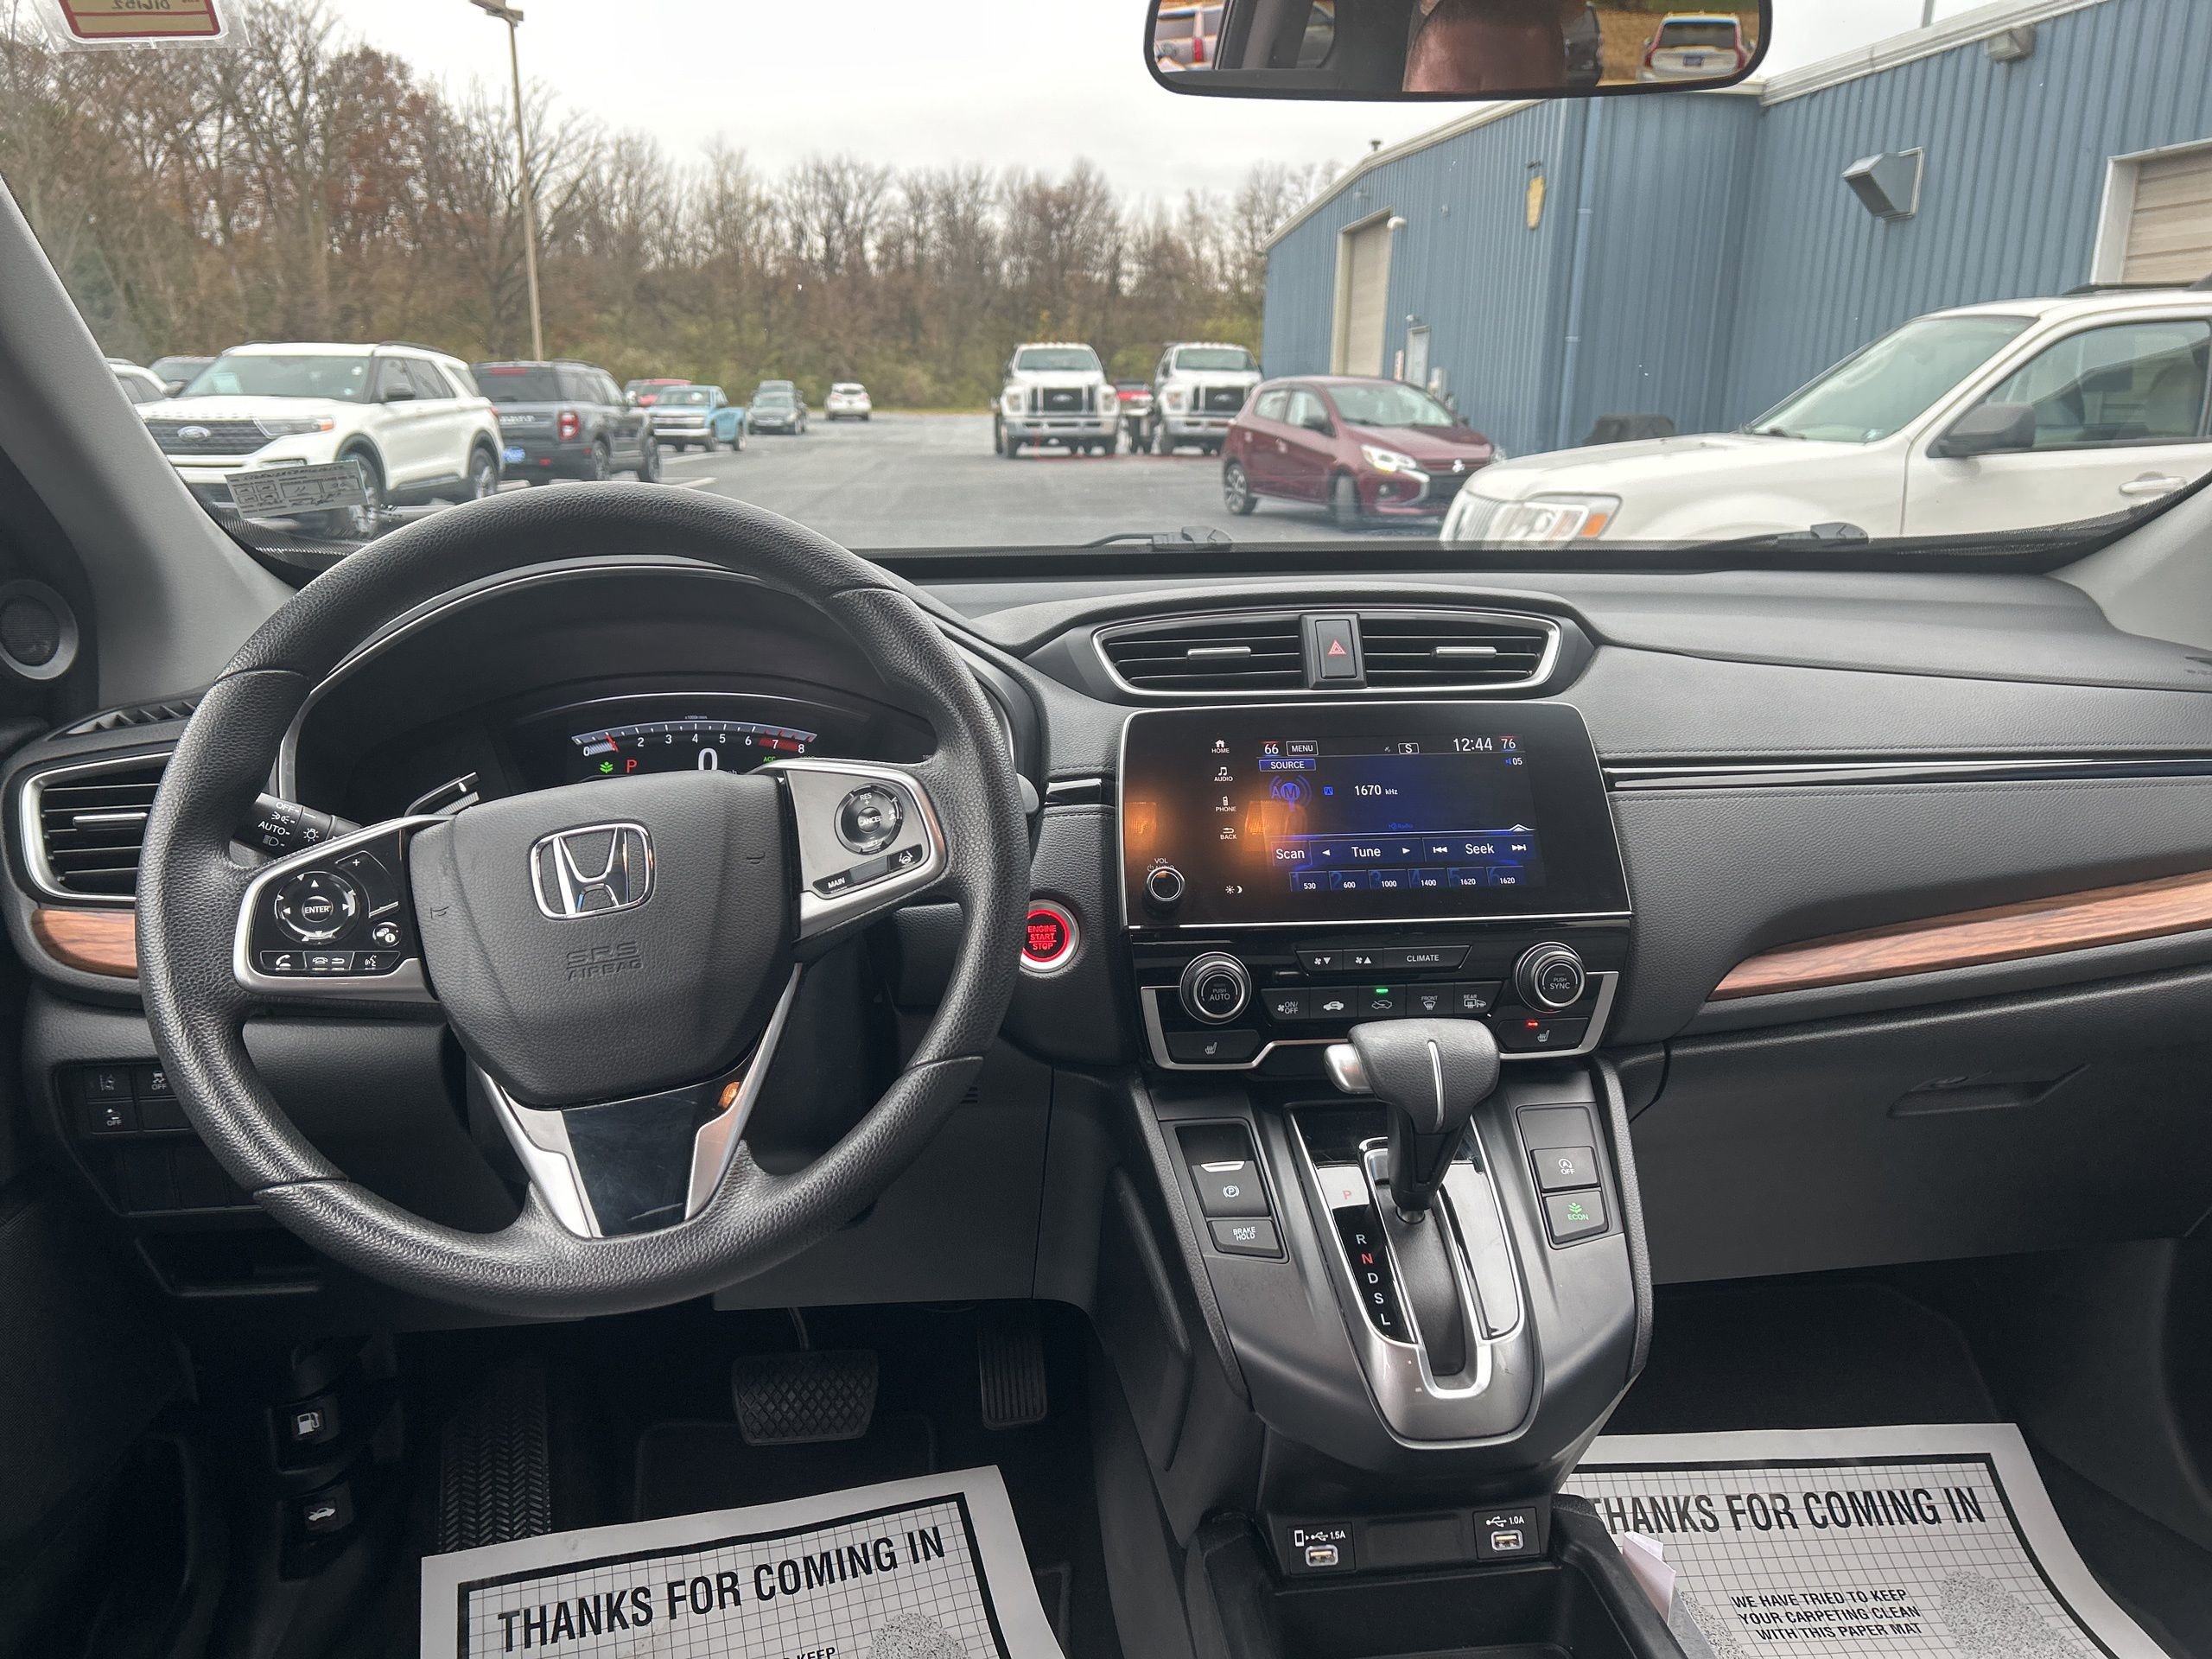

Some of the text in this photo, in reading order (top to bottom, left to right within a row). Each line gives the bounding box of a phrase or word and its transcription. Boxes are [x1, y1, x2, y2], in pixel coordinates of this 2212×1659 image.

[583, 733, 805, 757] 0 2 3 4 5 6 7 8
[1264, 743, 1313, 755] 66 MENU
[1404, 744, 1413, 753] S
[1452, 737, 1516, 752] 12:44 76
[626, 759, 637, 773] P
[1270, 760, 1306, 770] SOURCE
[1512, 757, 1523, 766] 05
[1354, 785, 1382, 796] 1670
[859, 792, 872, 801] RES
[276, 801, 296, 813] OFF
[257, 821, 286, 836] AUTO
[1275, 848, 1306, 860] Scan
[1351, 846, 1382, 858] Tune
[1465, 843, 1495, 855] Seek
[827, 877, 846, 889] MAIN
[1303, 881, 1316, 890] 530
[1343, 880, 1356, 889] 600
[304, 906, 330, 914] ENTER
[1027, 925, 1057, 933] ENGINE
[1406, 954, 1440, 963] CLIMATE
[1549, 982, 1570, 990] SYNC
[1209, 993, 1230, 1001] AUTO
[1342, 1190, 1352, 1200] P
[1232, 1226, 1256, 1236] BRAKE
[1236, 1233, 1255, 1242] HOLD
[1355, 1234, 1367, 1245] R
[1361, 1253, 1374, 1264] N
[1367, 1273, 1379, 1285] D
[1375, 1293, 1384, 1305] S
[1380, 1313, 1391, 1326] L
[1726, 1492, 1801, 1533] FOR
[1804, 1488, 1942, 1532] COMING
[1943, 1486, 1986, 1524] IN
[1509, 1516, 1525, 1526] 1.0A
[1330, 1530, 1346, 1540] 1.5A
[497, 1525, 945, 1652] THANKS FOR COMING IN
[1731, 1589, 1908, 1609] WE HAVE TRIED TO KEEP
[1738, 1605, 1922, 1625] YOUR CARPETING CLEAN
[1756, 1623, 1923, 1641] WITH THIS PAPER MAT
